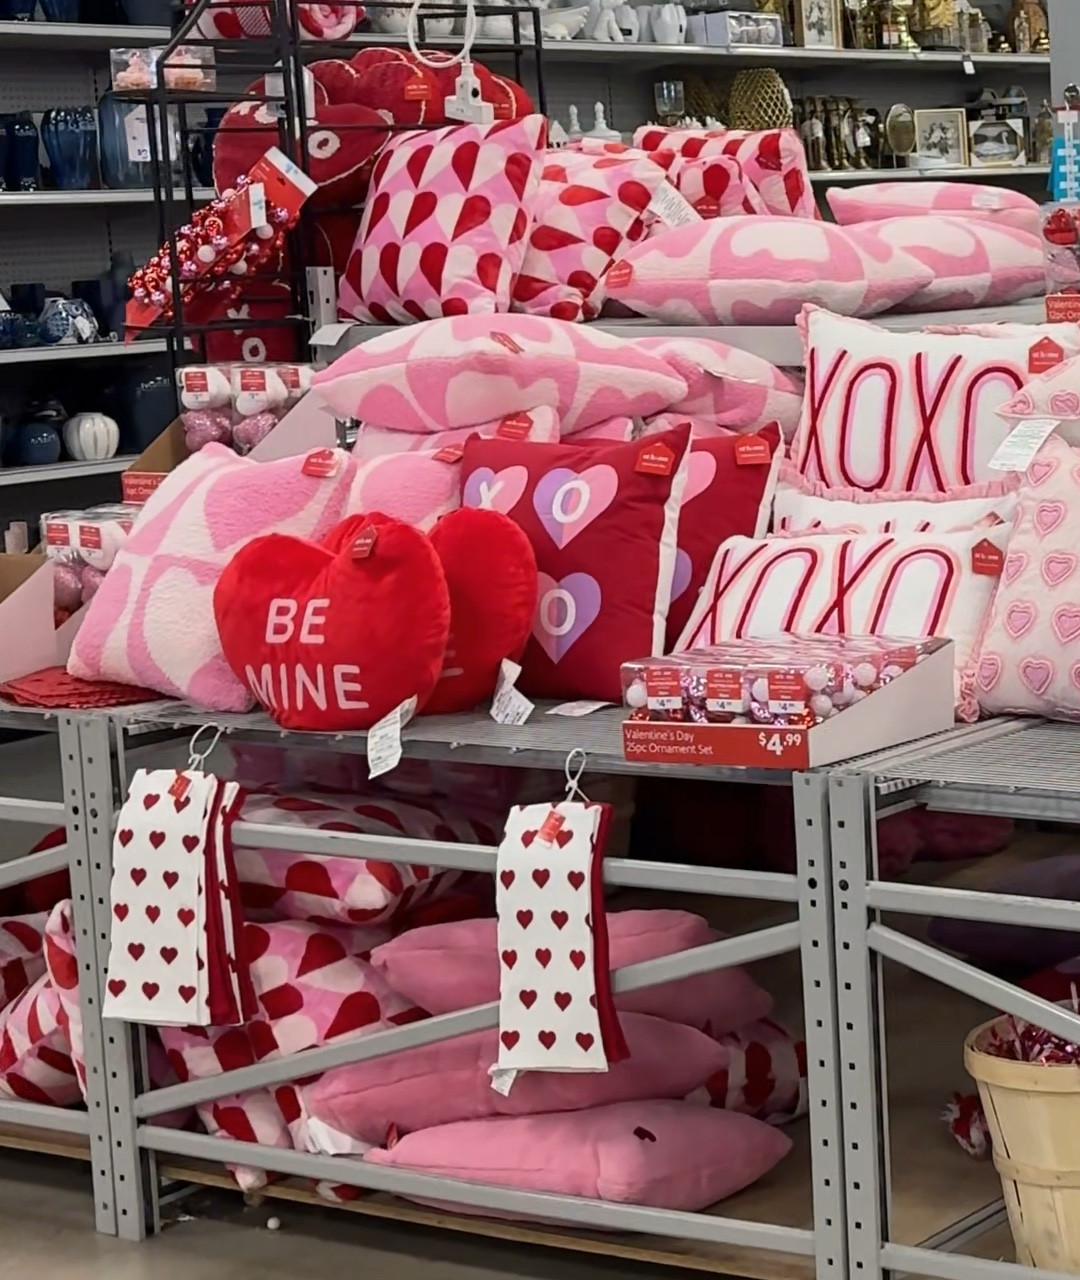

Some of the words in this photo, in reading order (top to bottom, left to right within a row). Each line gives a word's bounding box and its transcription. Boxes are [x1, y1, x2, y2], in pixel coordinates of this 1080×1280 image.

[800, 346, 1029, 493] XOXO
[684, 538, 962, 650] XOXO
[265, 597, 331, 645] BE
[245, 663, 370, 712] MINE
[625, 729, 674, 741] Valentine's
[676, 729, 694, 742] Day
[759, 732, 801, 755] $4.99
[626, 741, 647, 754] 25pc
[649, 743, 697, 755] Ornament
[698, 744, 713, 755] Set
